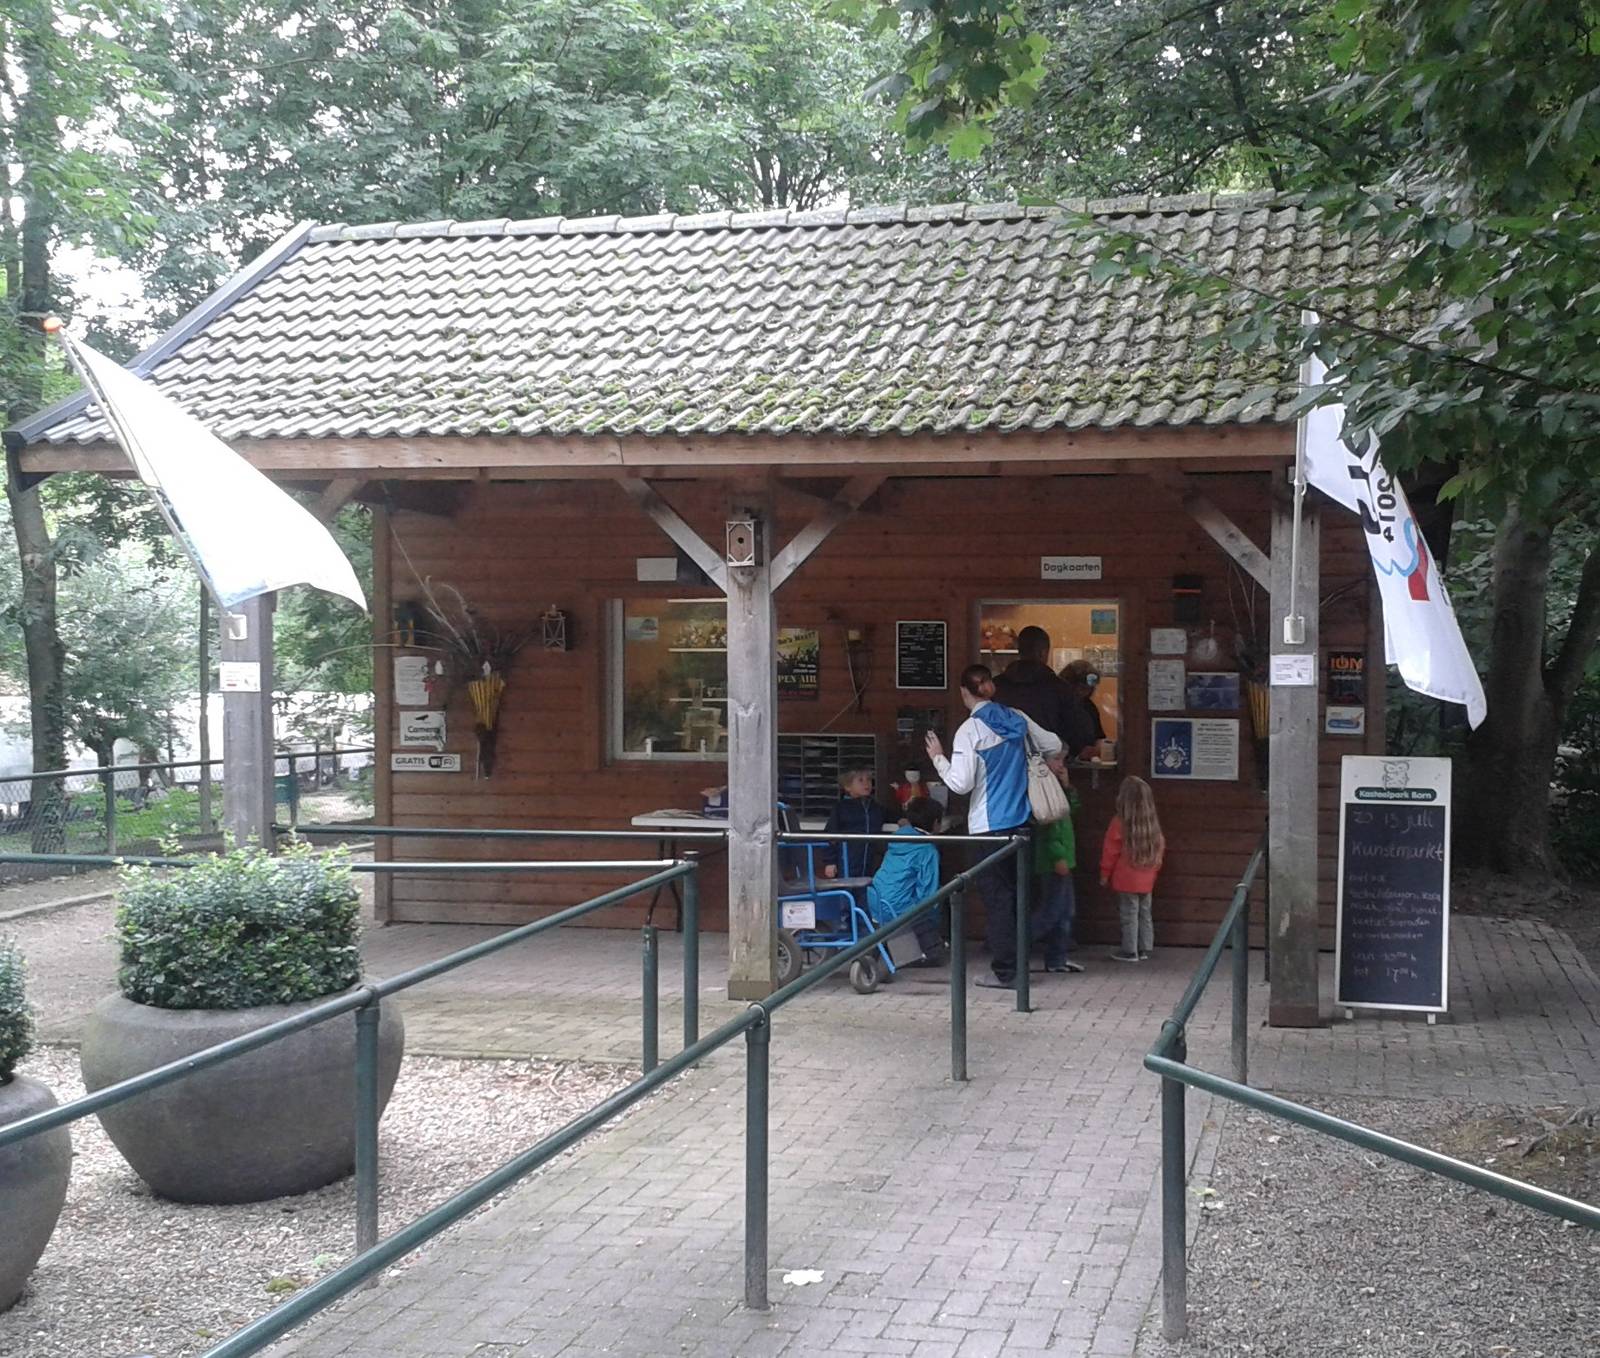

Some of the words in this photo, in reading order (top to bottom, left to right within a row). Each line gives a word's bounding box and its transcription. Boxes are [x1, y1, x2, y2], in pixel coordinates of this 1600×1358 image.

[1043, 563, 1100, 573] Dagkaarten
[395, 757, 426, 765] GRATIS
[1359, 790, 1409, 799] Kasteelpark
[1411, 791, 1432, 799] Born
